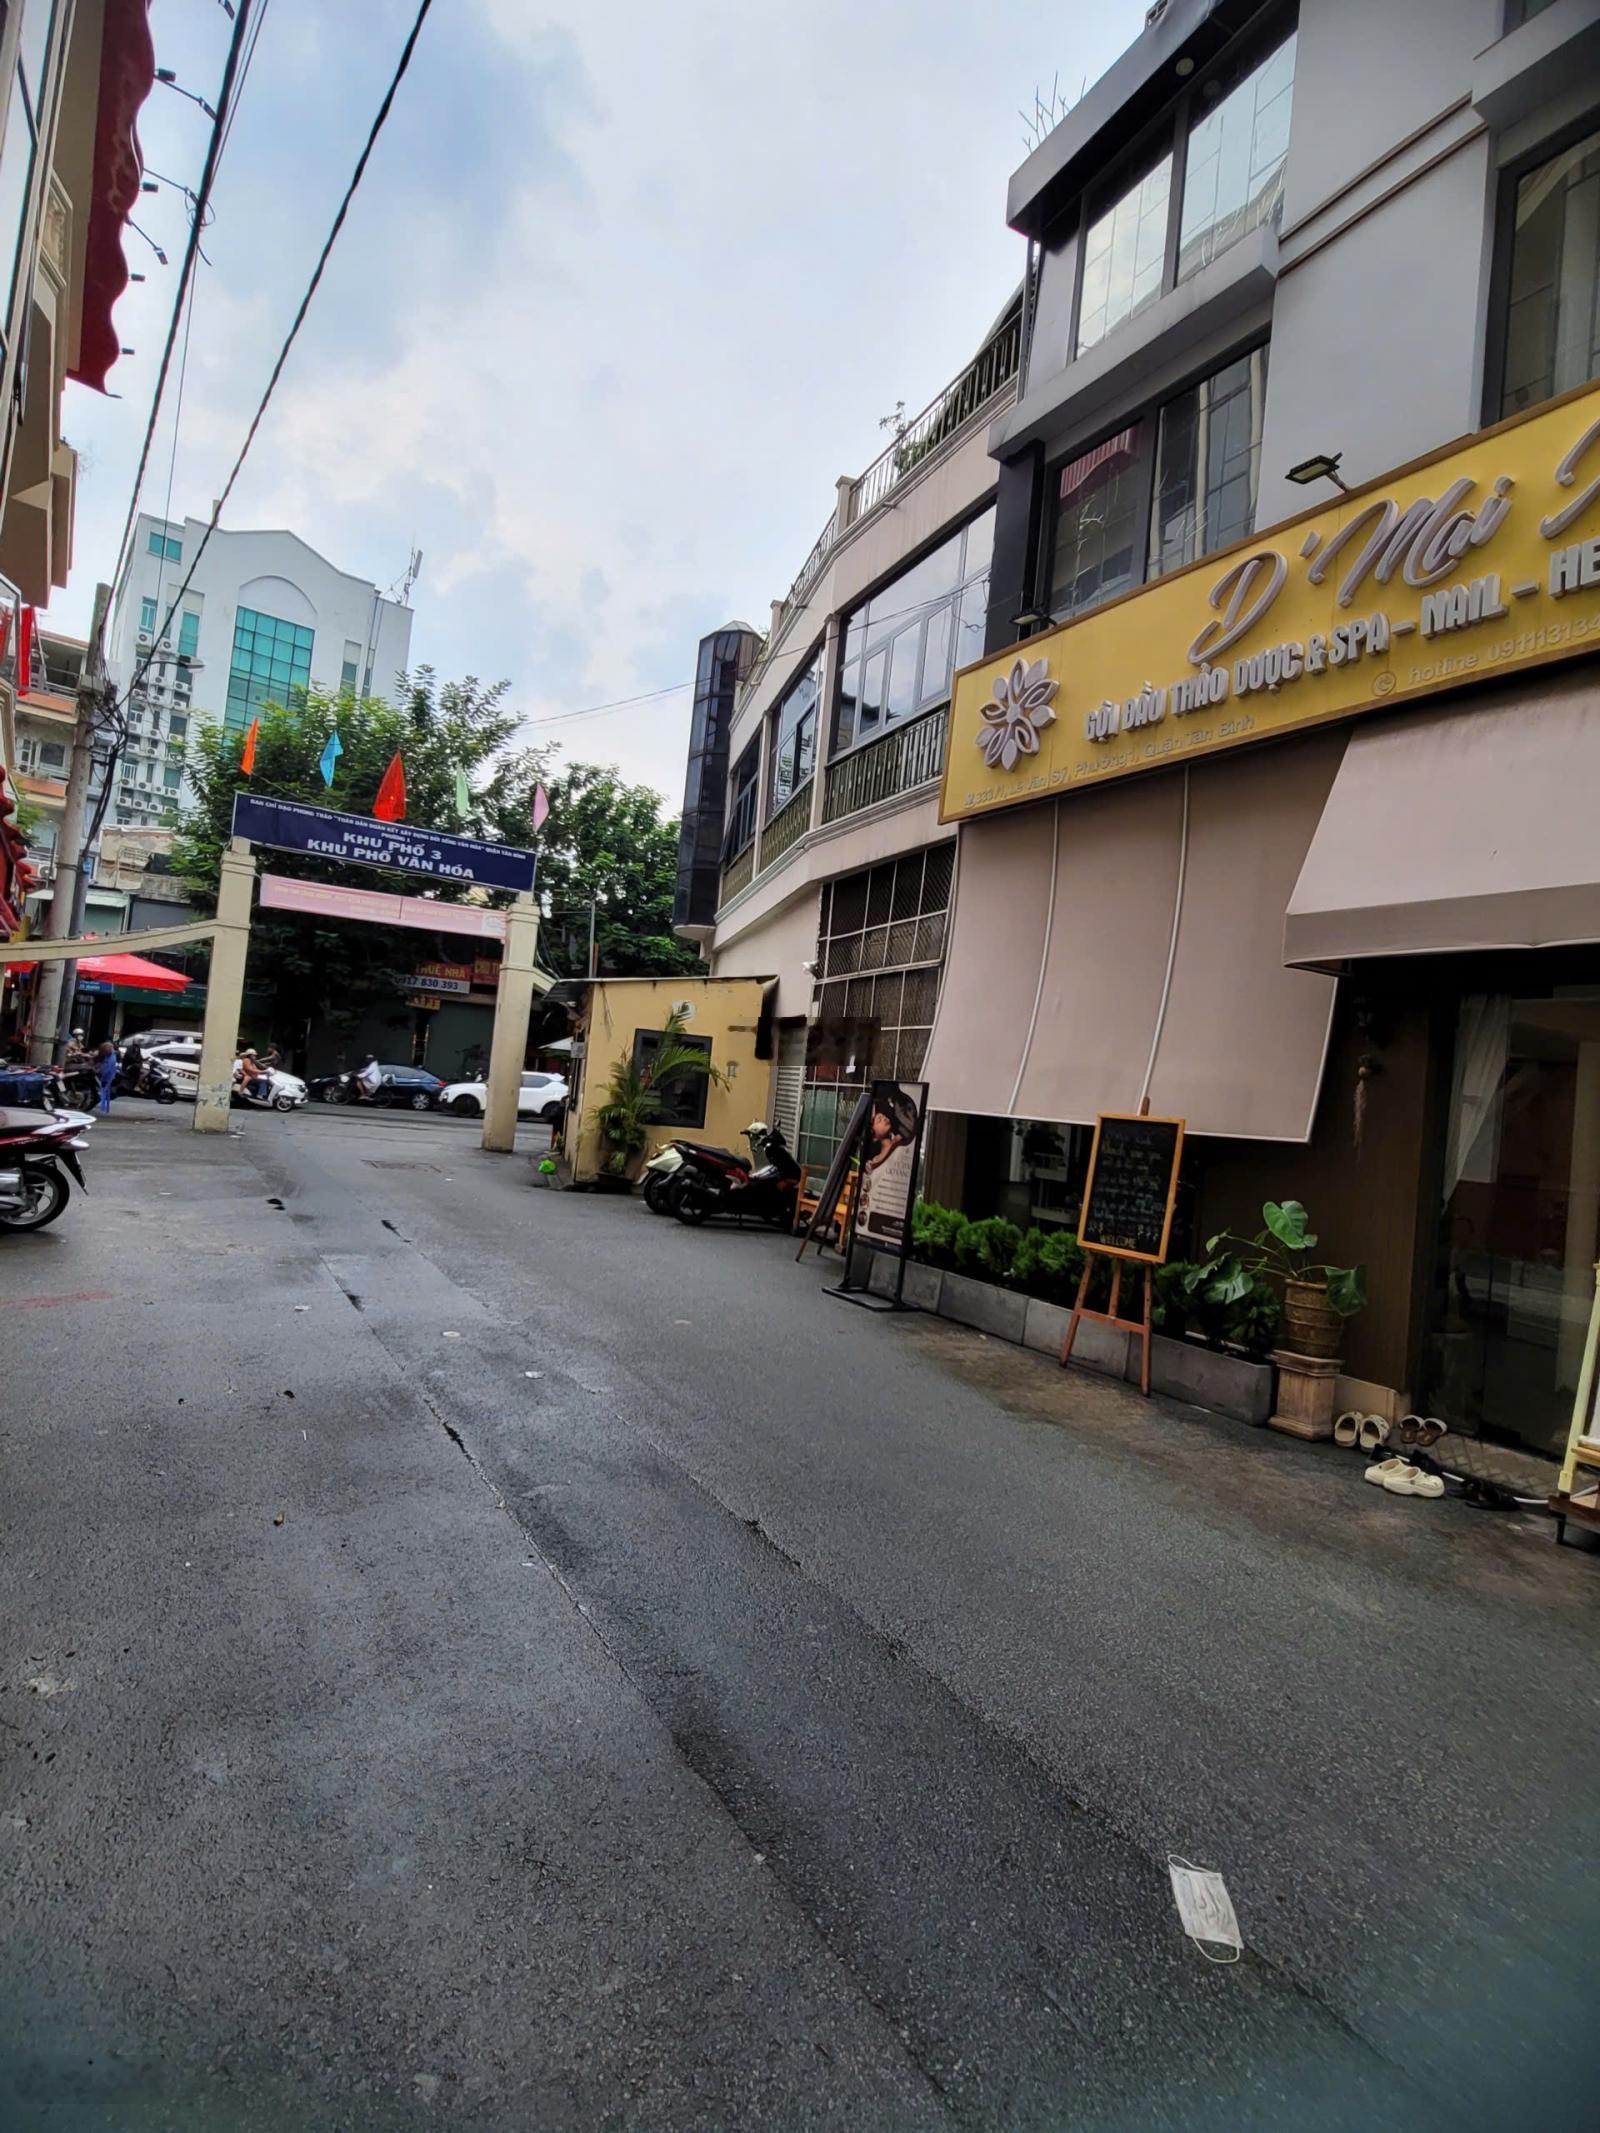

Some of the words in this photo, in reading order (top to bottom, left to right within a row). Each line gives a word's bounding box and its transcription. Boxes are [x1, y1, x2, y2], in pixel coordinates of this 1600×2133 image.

[1305, 634, 1329, 674] &
[1328, 612, 1390, 666] SPA
[1420, 573, 1508, 639] NAIL
[1408, 652, 1480, 684] hotline
[307, 839, 348, 855] KHU
[353, 847, 393, 863] PHỐ
[397, 854, 433, 871] VĂN
[438, 863, 474, 879] HÓA
[343, 832, 382, 848] KHU
[388, 841, 425, 857] PHỐ
[431, 850, 442, 860] 3
[441, 980, 459, 990] 393
